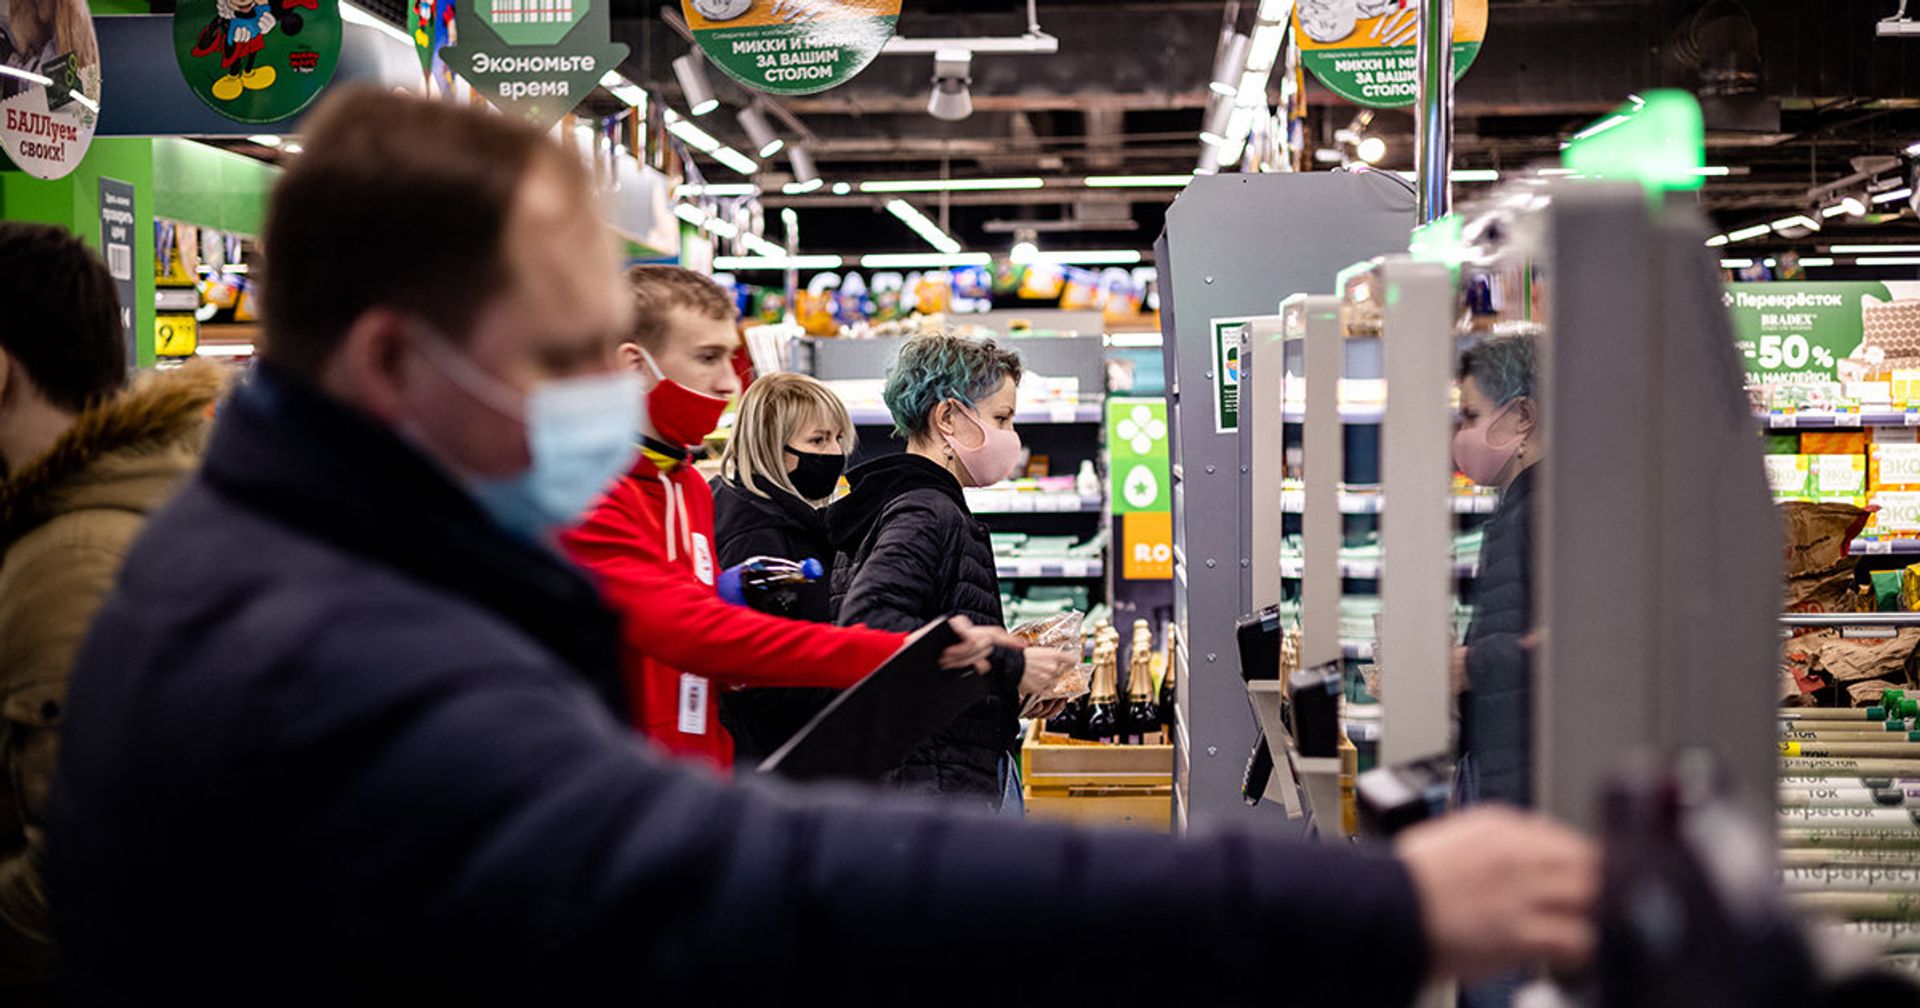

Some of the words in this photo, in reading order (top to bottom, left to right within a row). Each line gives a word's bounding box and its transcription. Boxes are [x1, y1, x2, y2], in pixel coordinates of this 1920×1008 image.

[732, 38, 787, 54] МИККИ
[791, 37, 801, 51] И
[472, 52, 596, 73] Экономьте
[756, 54, 777, 68] ЗА
[780, 50, 839, 67] ВАШИМ
[1335, 58, 1383, 72] МИККИ
[1386, 57, 1396, 70] И
[764, 65, 833, 82] СТОЛОМ
[1355, 72, 1374, 84] ЗА
[499, 80, 569, 100] время
[6, 108, 77, 143] БАЛЛуем
